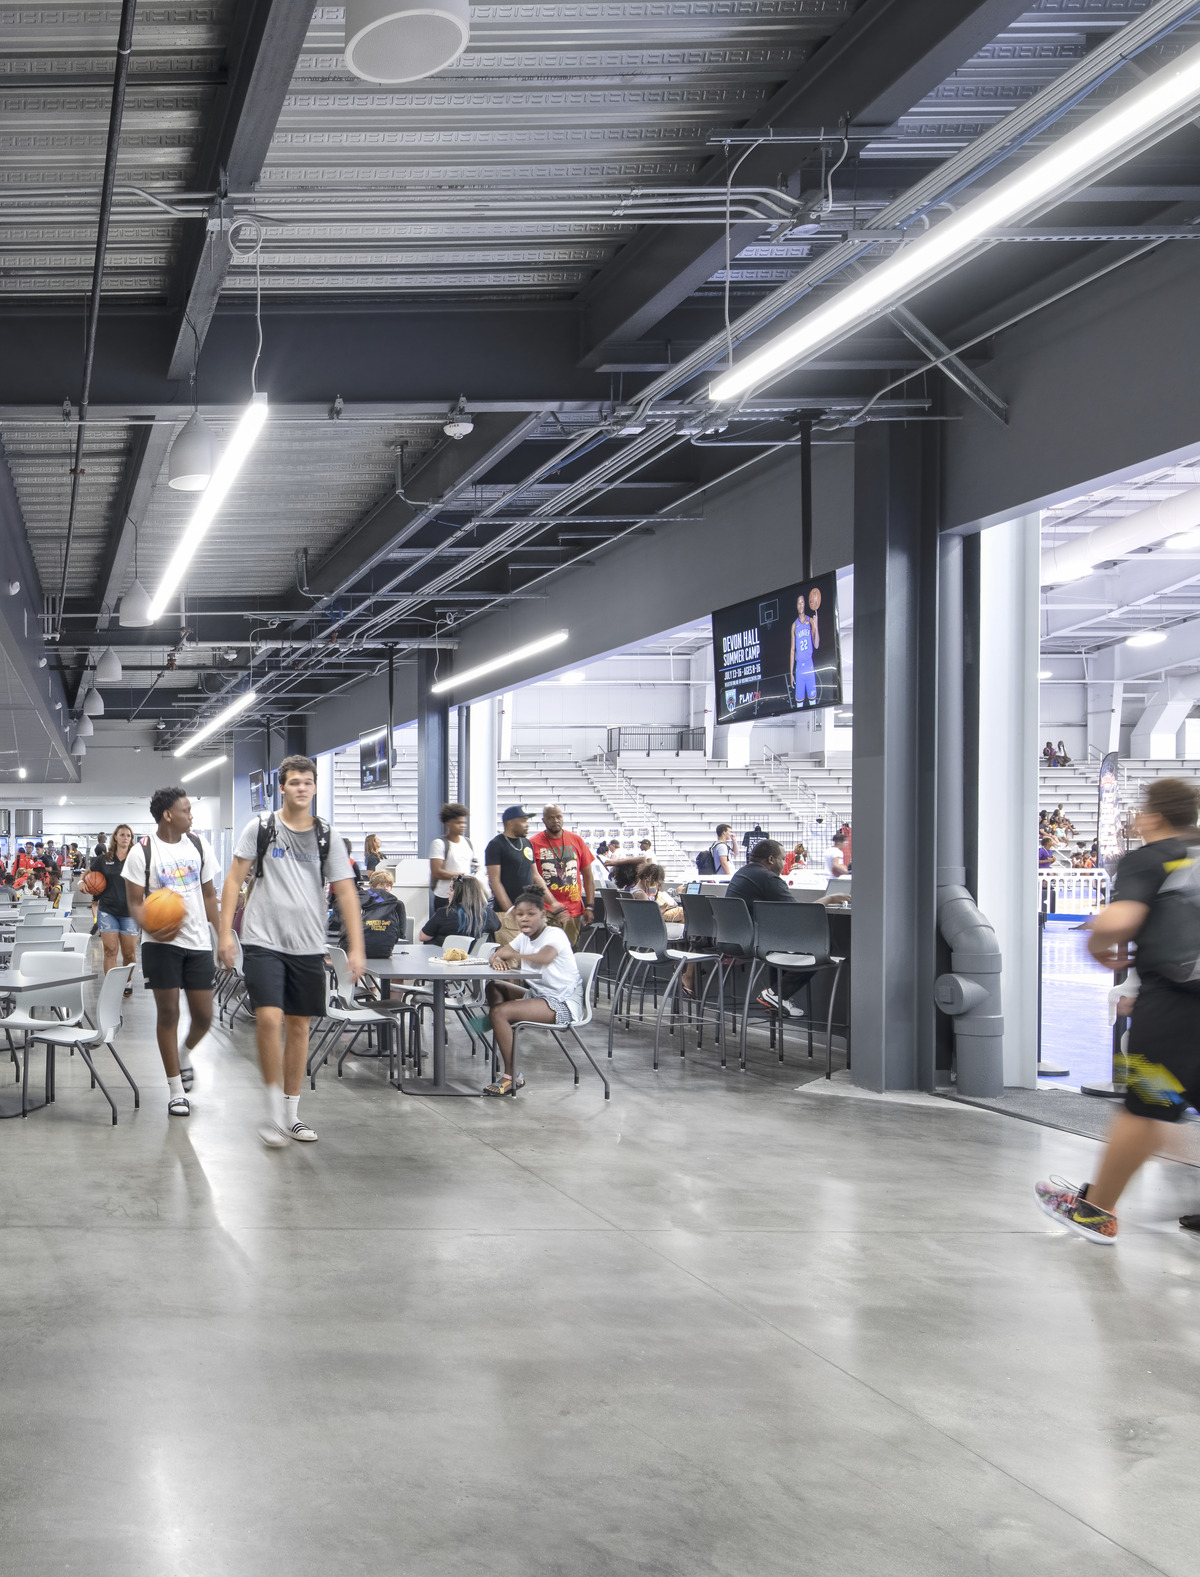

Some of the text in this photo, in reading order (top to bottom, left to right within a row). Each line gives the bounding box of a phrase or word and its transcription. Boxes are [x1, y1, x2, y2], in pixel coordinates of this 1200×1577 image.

[722, 628, 760, 652] DEVON HALL
[800, 639, 808, 651] 22
[724, 645, 760, 666] SUMMER CAMP
